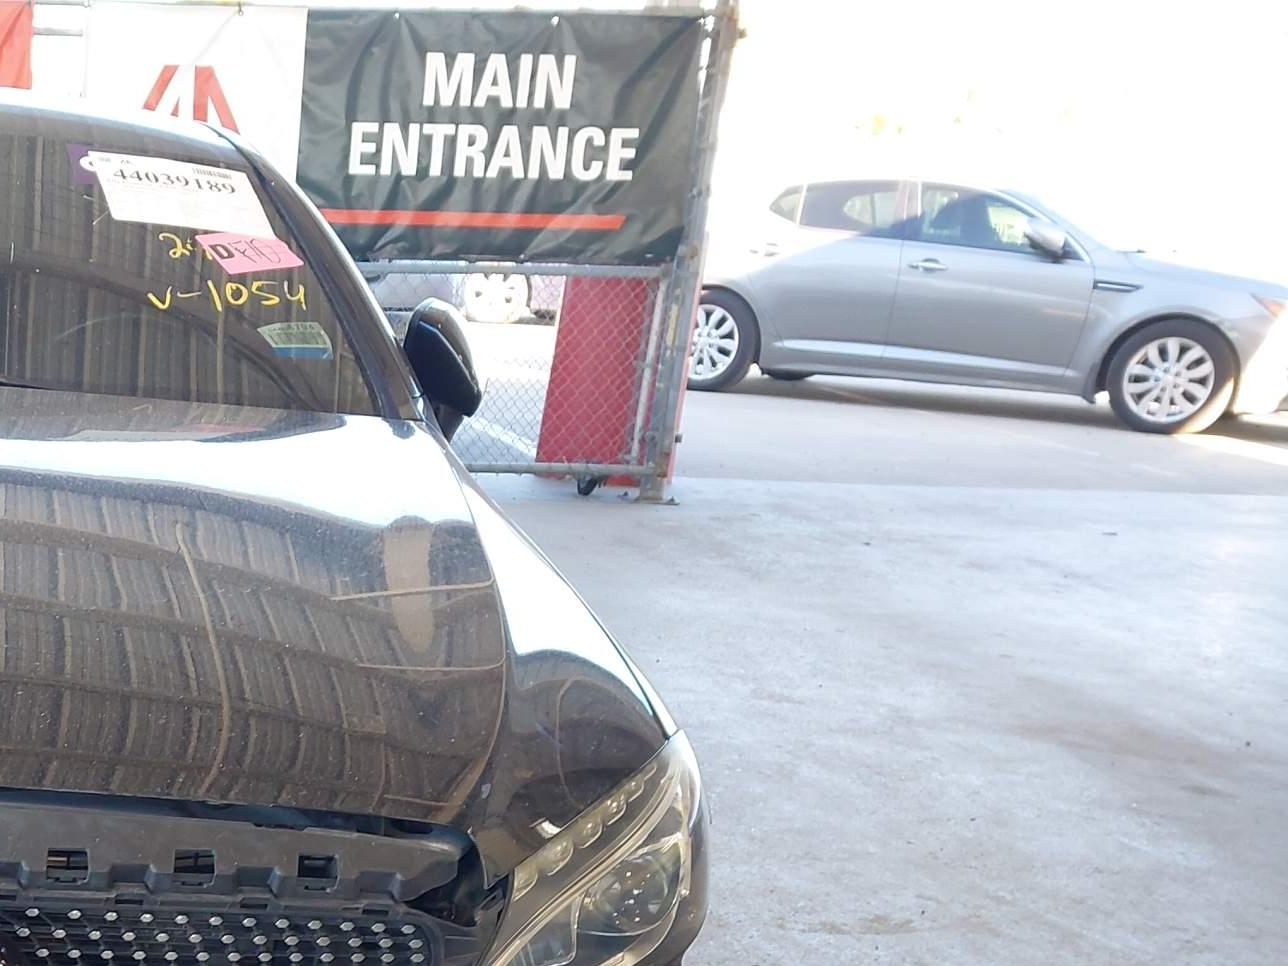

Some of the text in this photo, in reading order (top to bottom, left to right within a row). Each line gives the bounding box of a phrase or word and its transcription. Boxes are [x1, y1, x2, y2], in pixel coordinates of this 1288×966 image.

[423, 52, 577, 110] MAIN
[348, 121, 640, 182] ENTRANCE
[113, 167, 236, 195] 44039189
